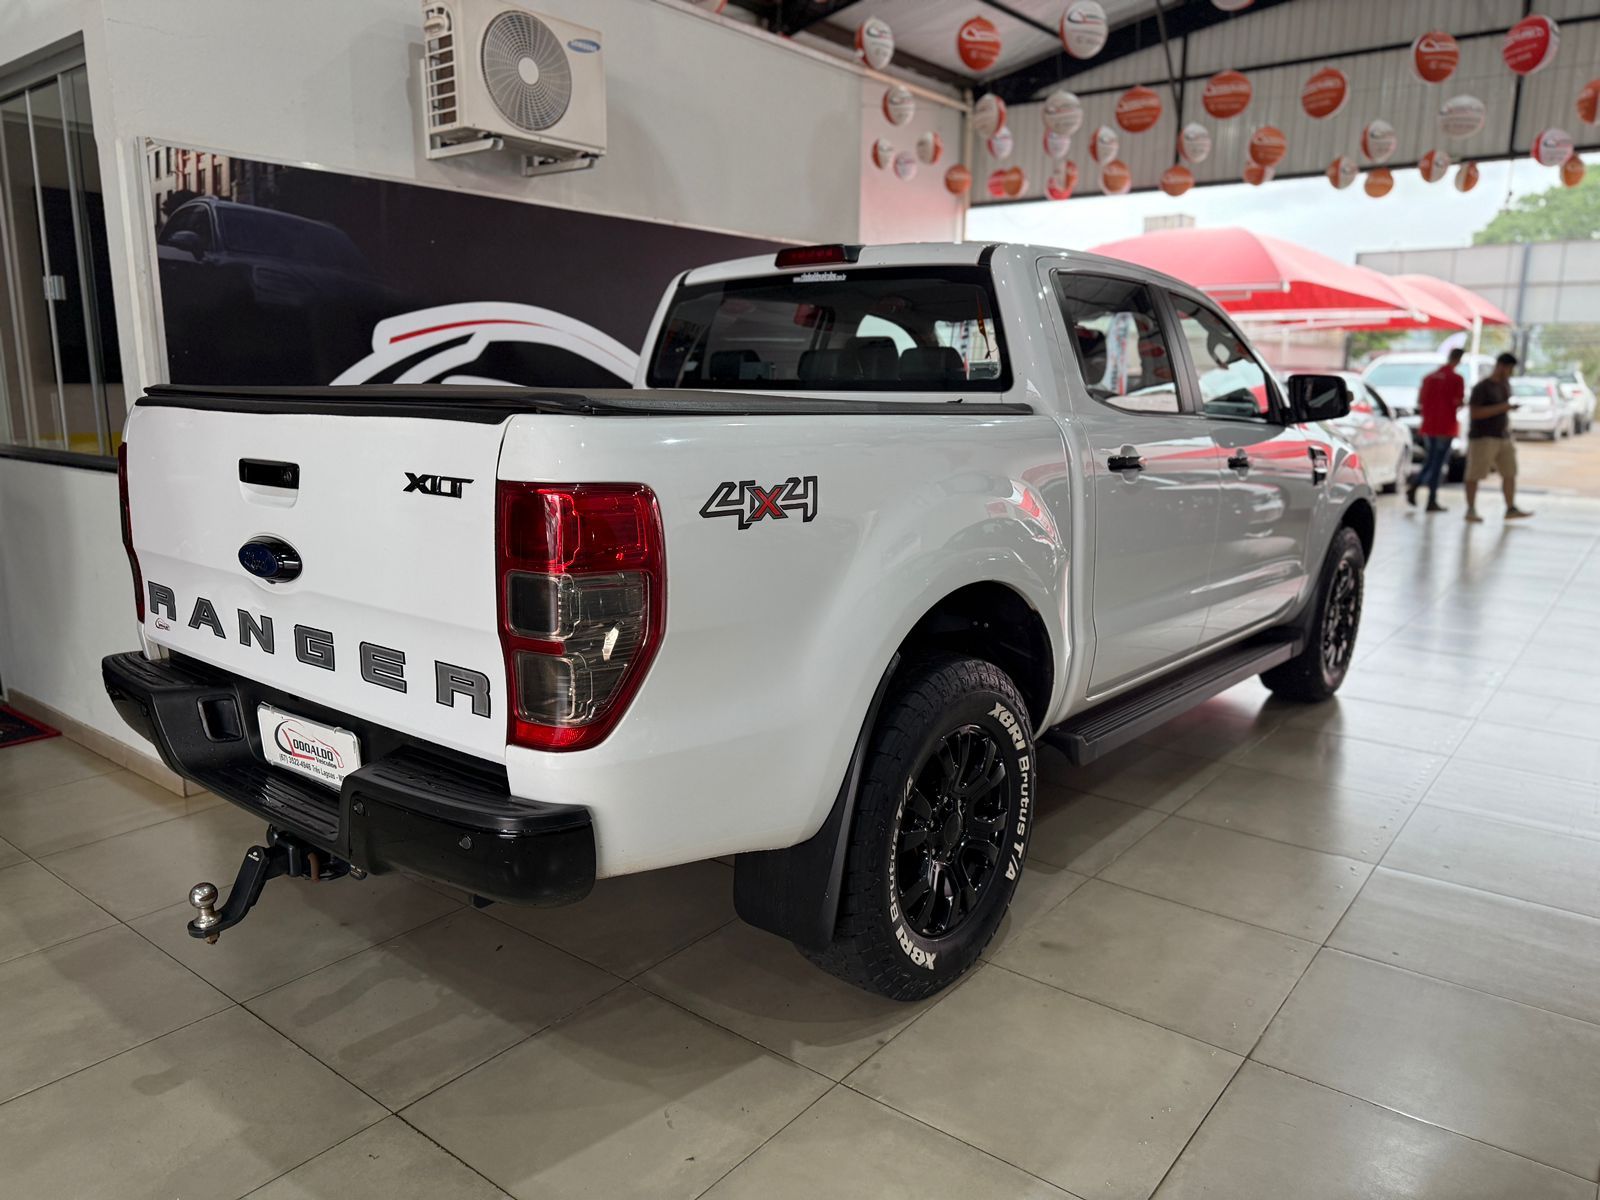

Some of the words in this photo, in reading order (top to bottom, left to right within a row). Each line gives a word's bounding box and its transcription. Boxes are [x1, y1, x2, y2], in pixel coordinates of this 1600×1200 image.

[403, 472, 475, 499] XLT
[148, 580, 492, 719] RANGER
[987, 702, 1027, 751] XBRI
[1016, 755, 1031, 837] Brutus
[1004, 841, 1025, 882] T/A
[895, 925, 937, 971] XBRI
